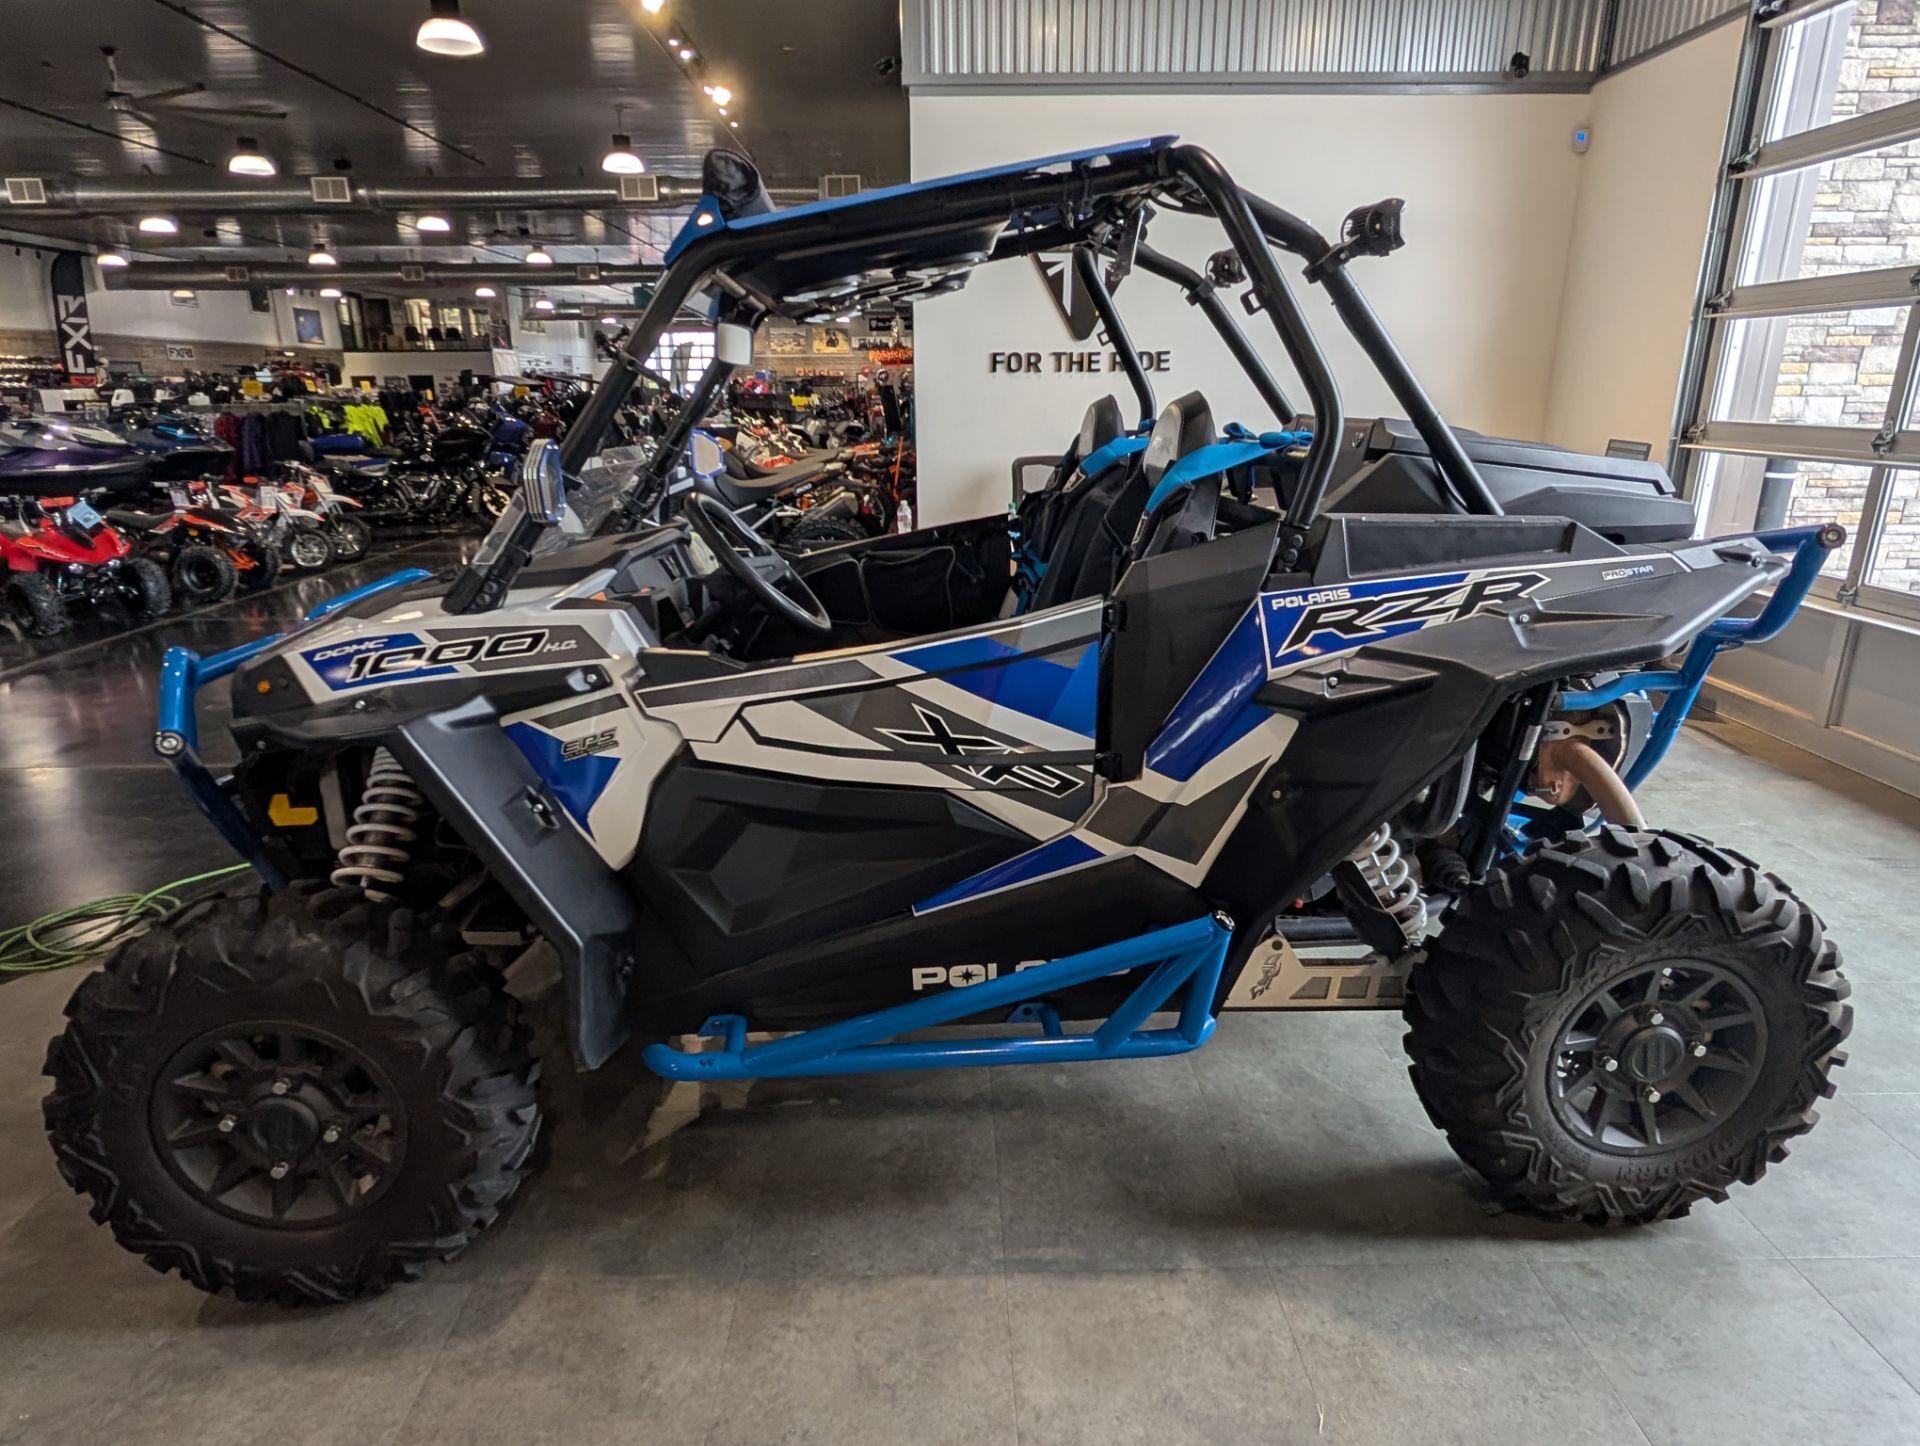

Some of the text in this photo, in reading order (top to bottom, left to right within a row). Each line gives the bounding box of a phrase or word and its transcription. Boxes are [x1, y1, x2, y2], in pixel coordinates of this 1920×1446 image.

[57, 294, 95, 373] FXR
[989, 351, 1170, 373] FOR THE RDE
[1602, 565, 1654, 580] PROSTAR
[1271, 588, 1351, 610] POLARIS
[1275, 571, 1551, 657] RZR
[313, 639, 389, 661] DOHC
[346, 628, 549, 682] 1000
[561, 726, 618, 756] EPS
[873, 702, 1085, 798] XP
